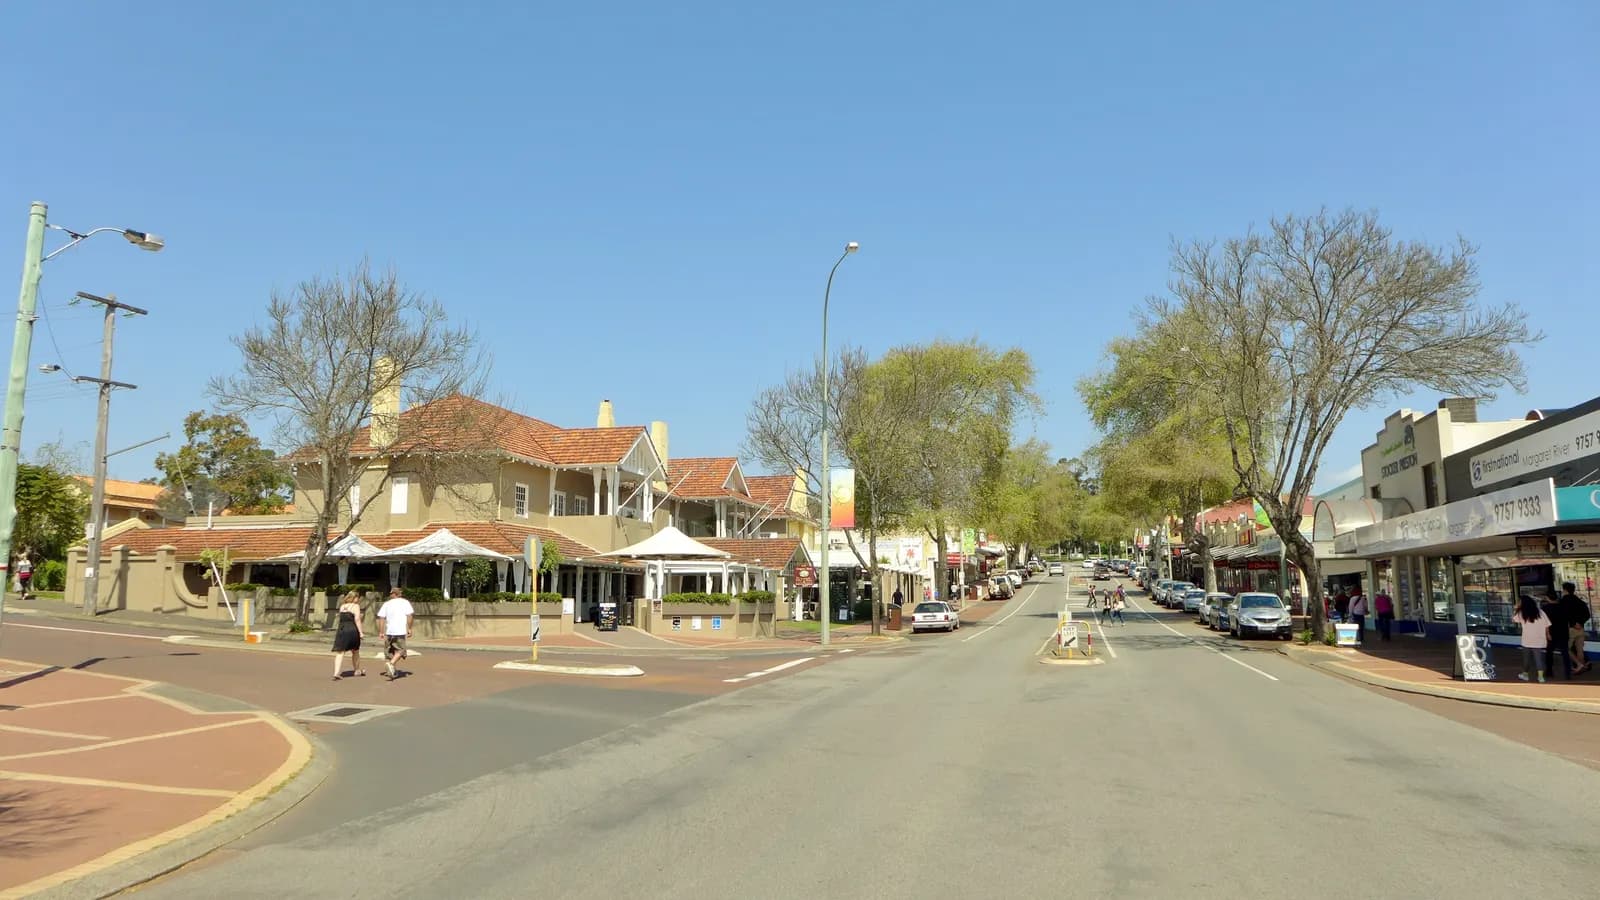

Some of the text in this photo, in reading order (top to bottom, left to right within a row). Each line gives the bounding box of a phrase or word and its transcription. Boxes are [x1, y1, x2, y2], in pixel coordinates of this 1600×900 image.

[1482, 448, 1519, 473] firstnational
[1575, 432, 1593, 451] 9757
[1494, 500, 1515, 523] 9757
[1518, 495, 1541, 518] 9333
